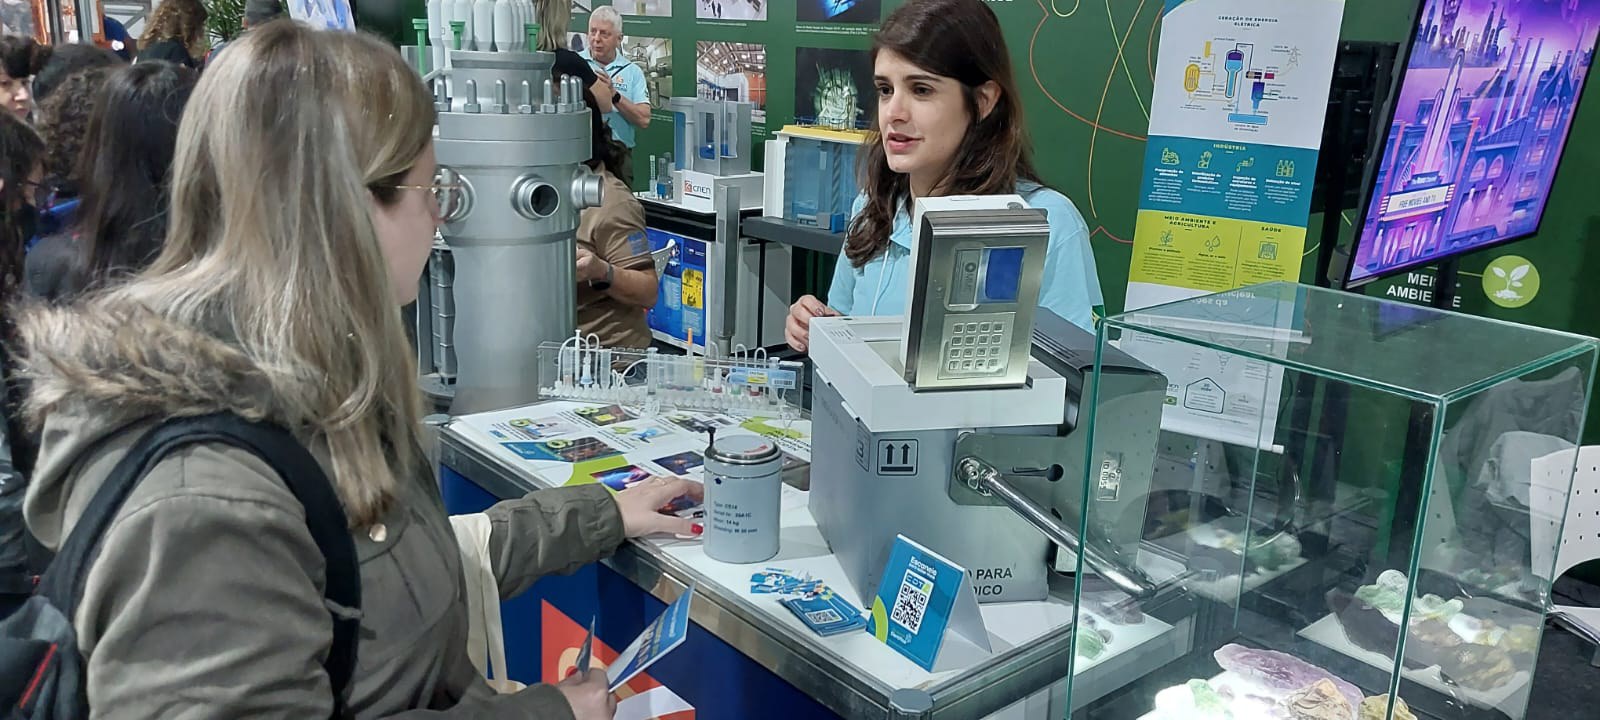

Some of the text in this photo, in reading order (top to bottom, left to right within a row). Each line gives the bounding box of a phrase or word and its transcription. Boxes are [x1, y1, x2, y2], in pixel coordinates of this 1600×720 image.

[1213, 143, 1246, 151] INDÚSTRIA
[1169, 221, 1210, 229] AGRICULTURA
[1181, 217, 1212, 225] AMBIENTE
[1408, 272, 1437, 287] MEI
[1386, 285, 1462, 308] AMBIEE
[976, 568, 1012, 580] PARA
